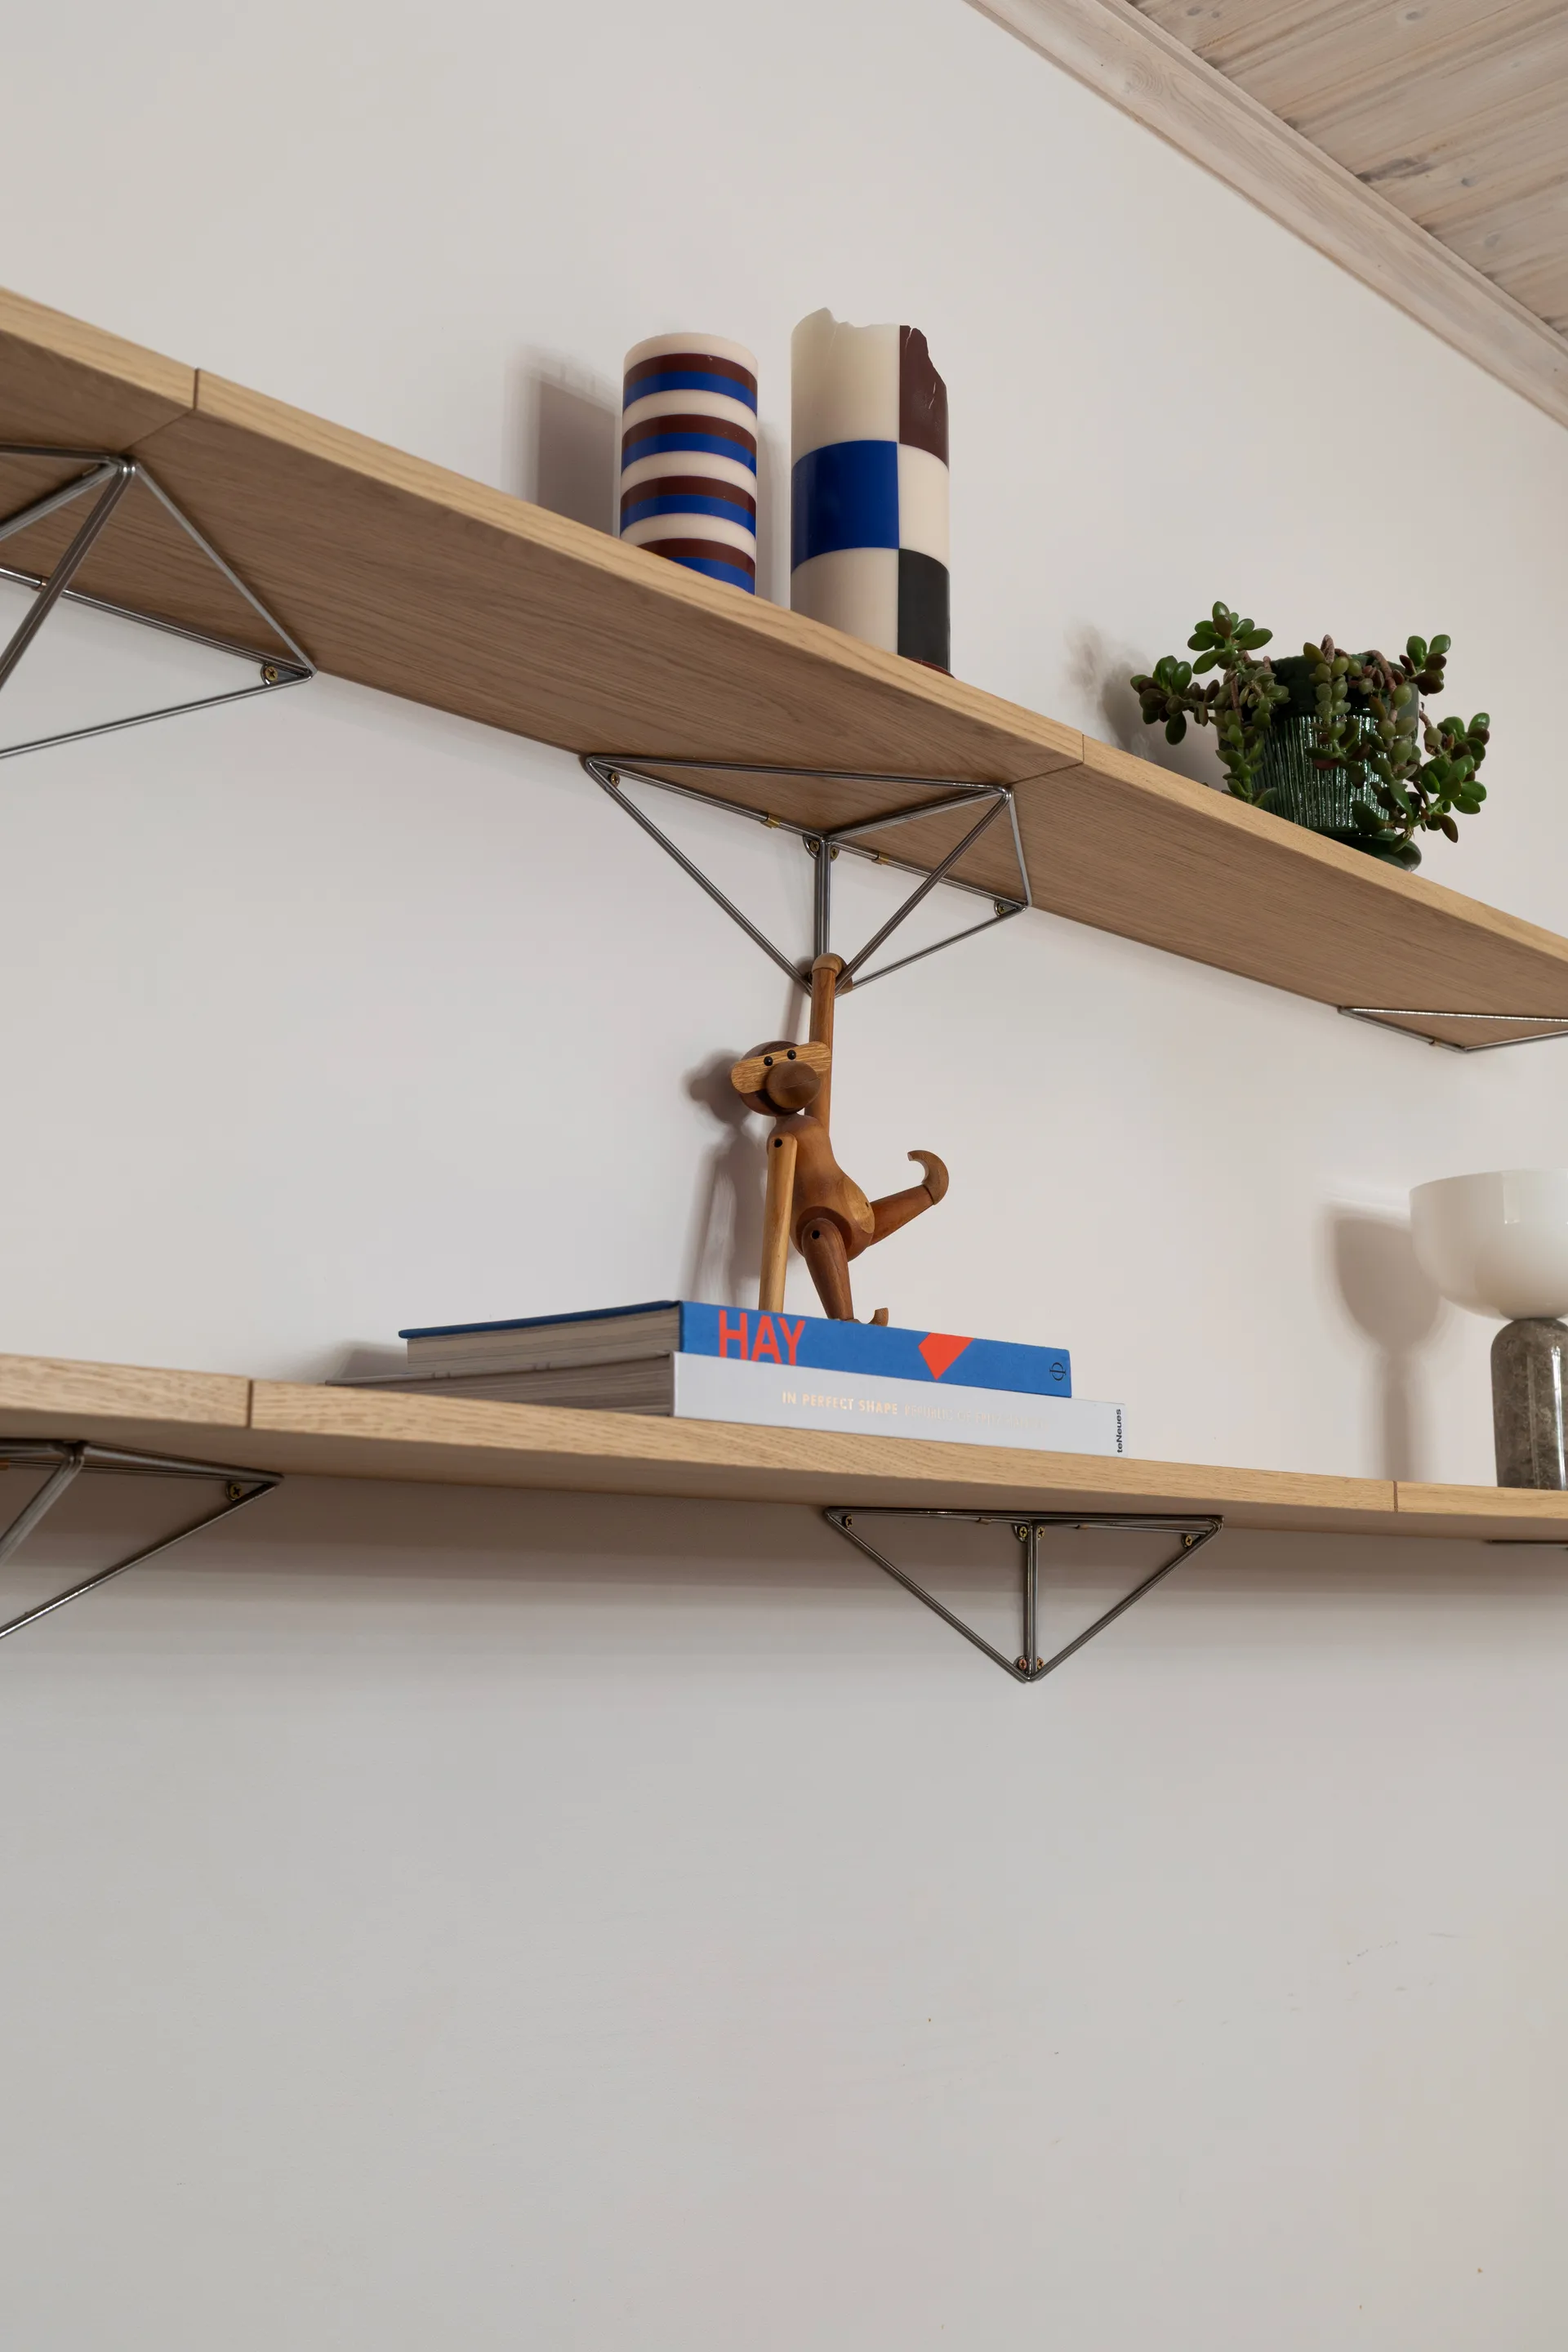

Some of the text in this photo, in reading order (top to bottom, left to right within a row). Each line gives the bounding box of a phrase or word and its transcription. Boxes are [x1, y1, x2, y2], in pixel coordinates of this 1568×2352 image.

[719, 1309, 806, 1366] HAY
[782, 1391, 797, 1405] IN
[802, 1392, 853, 1410] PERFECT
[858, 1399, 898, 1415] SHAPE
